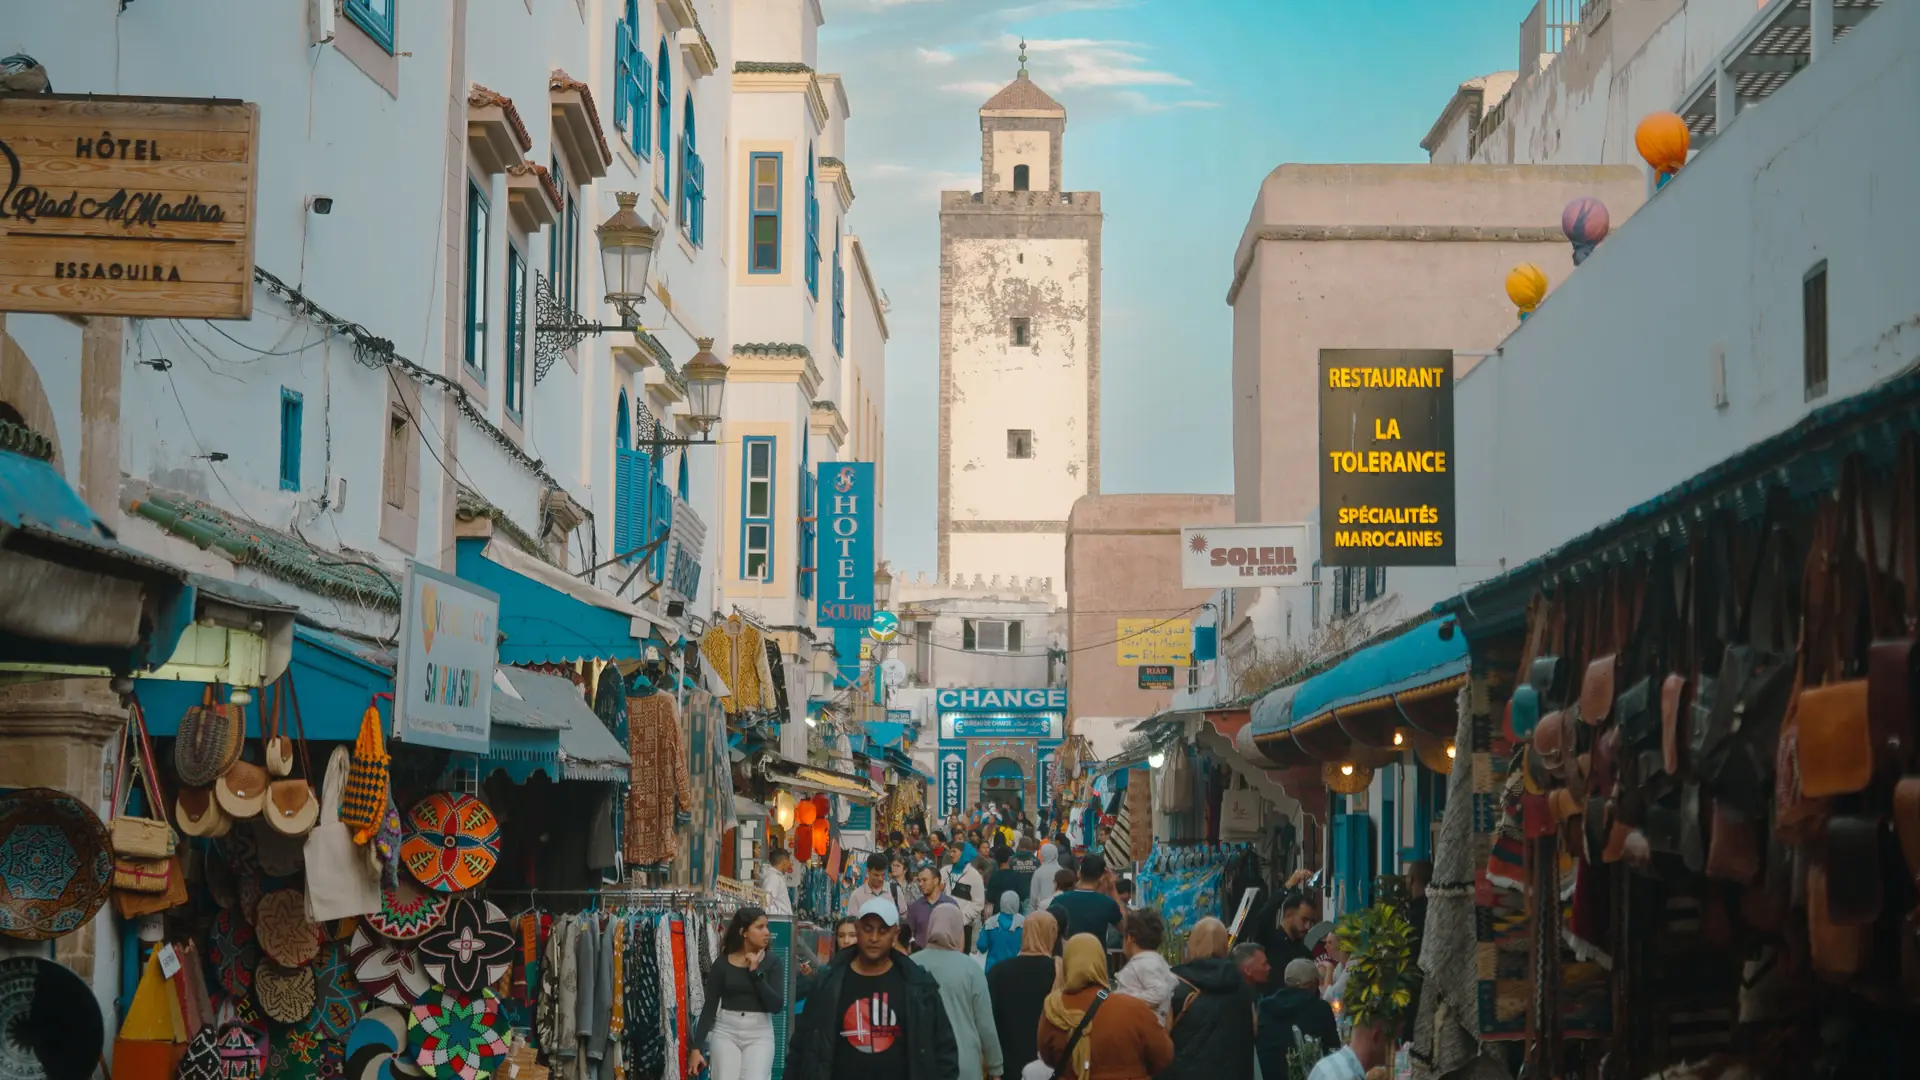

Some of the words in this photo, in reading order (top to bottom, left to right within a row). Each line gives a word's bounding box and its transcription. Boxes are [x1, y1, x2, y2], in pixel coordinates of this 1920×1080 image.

[76, 131, 161, 161] HÔTEL
[11, 186, 78, 223] Riad
[123, 191, 226, 229] Madina
[54, 262, 182, 282] ESSAOUIRA
[1328, 367, 1444, 388] RESTAURANT
[1375, 418, 1401, 440] LA
[1329, 451, 1446, 473] TOLERANCE
[1338, 504, 1439, 524] SPÉCIALITÉS
[833, 495, 858, 600] HOTEL
[1334, 531, 1443, 547] MAROCAINES
[1210, 546, 1297, 566] SOLEIL
[1239, 566, 1254, 576] LE
[1257, 565, 1297, 576] SHOP
[1146, 667, 1168, 675] RIAD
[938, 690, 1066, 708] CHANGE
